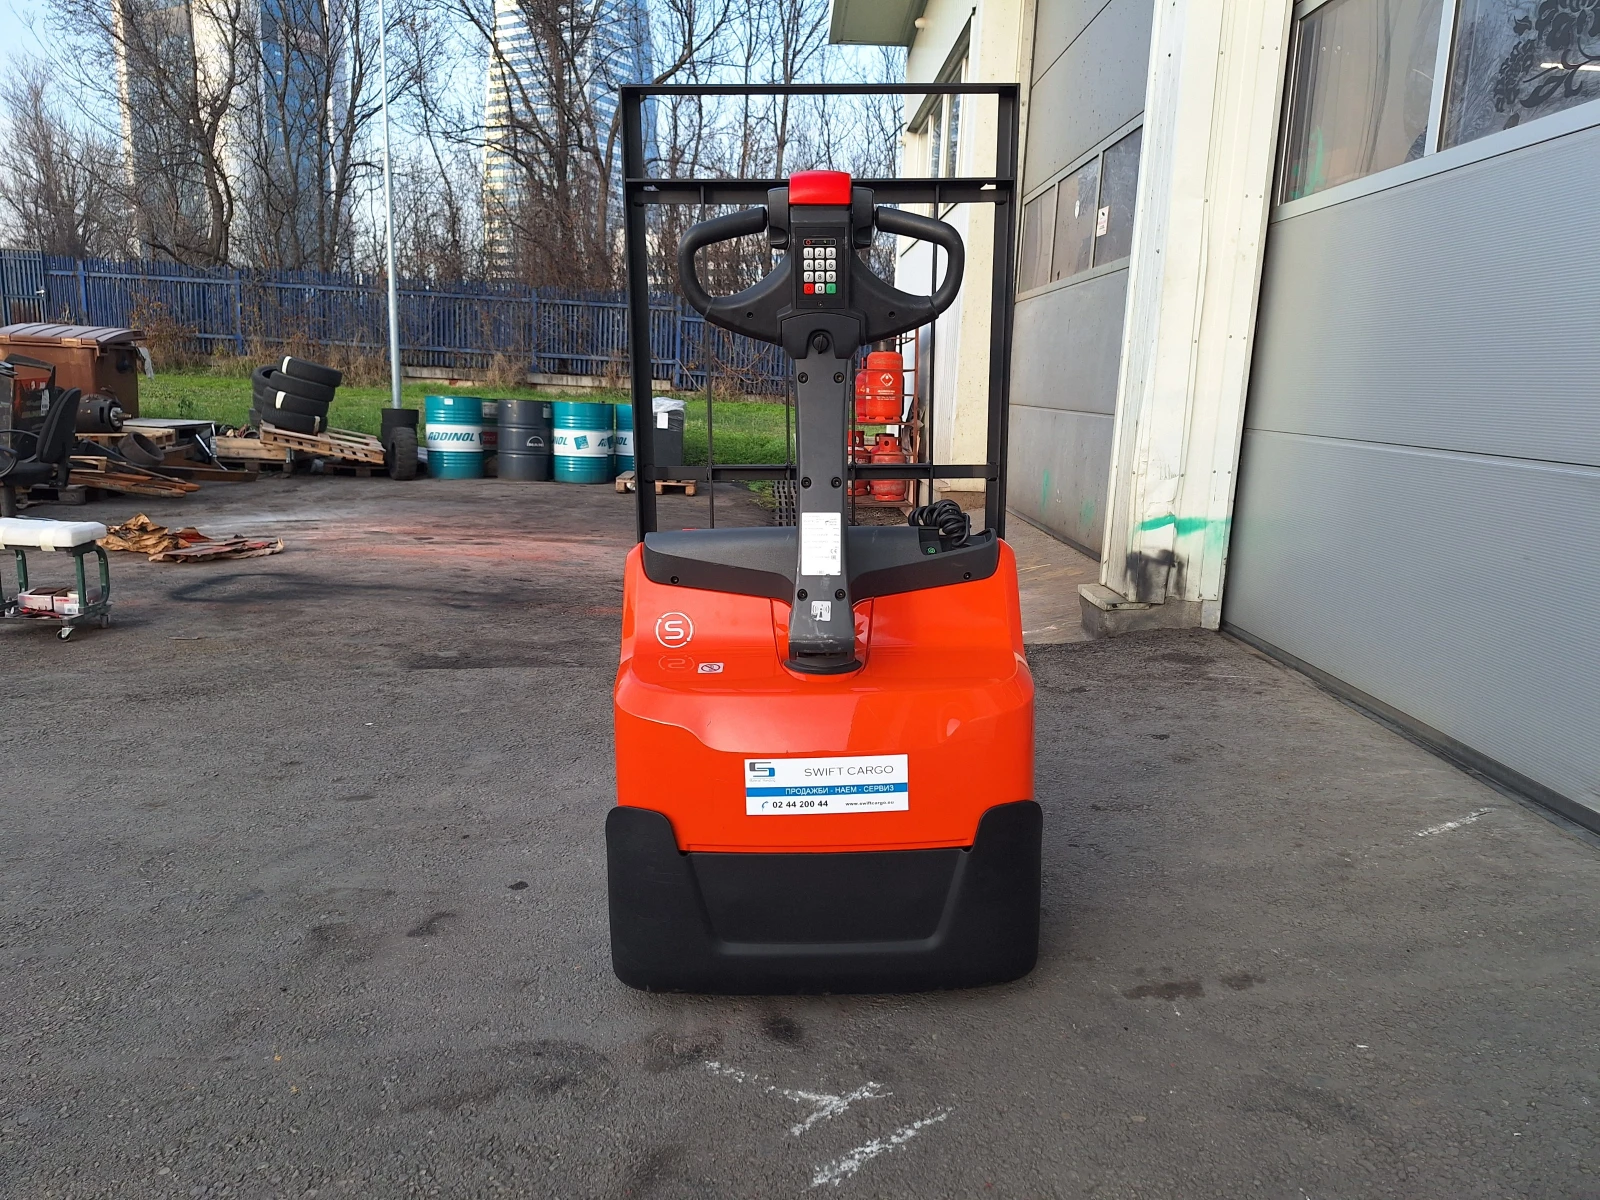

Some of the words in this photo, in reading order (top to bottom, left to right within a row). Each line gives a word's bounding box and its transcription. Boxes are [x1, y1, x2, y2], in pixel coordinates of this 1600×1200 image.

[428, 431, 475, 442] ADDINOL
[804, 767, 844, 776] SWIFT
[847, 765, 894, 775] CARGO
[785, 787, 829, 796] ПРОДАЖБИ
[834, 785, 857, 793] НАЕМ
[863, 784, 895, 792] СЕРВИЗ
[799, 800, 815, 808] 200
